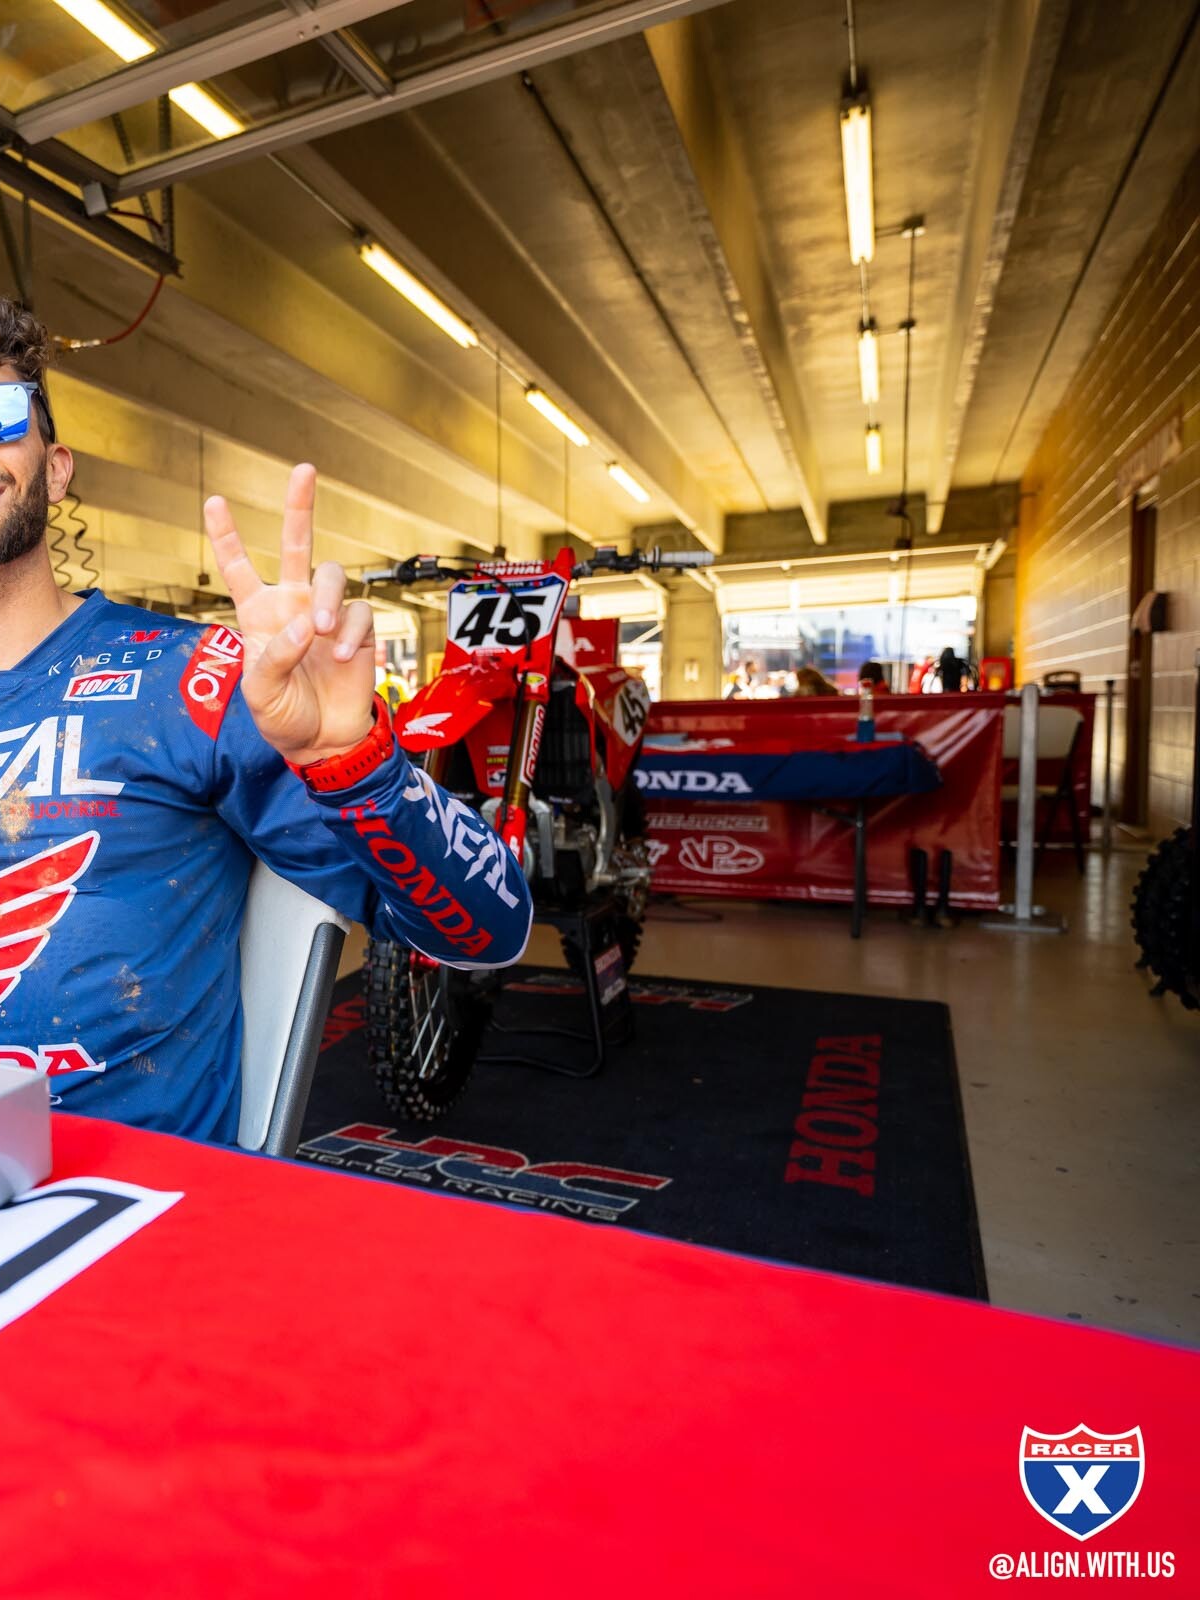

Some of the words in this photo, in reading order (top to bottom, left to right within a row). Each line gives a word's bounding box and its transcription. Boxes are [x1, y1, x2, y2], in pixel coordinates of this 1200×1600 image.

[455, 595, 547, 647] 45
[49, 649, 162, 676] KAGED
[74, 674, 131, 696] 100%
[188, 625, 244, 702] O'NE
[633, 770, 753, 794] ONDA
[340, 799, 495, 957] HONDA
[784, 1034, 883, 1196] HONDA
[299, 1122, 672, 1212] HRC
[443, 1179, 619, 1222] RACING
